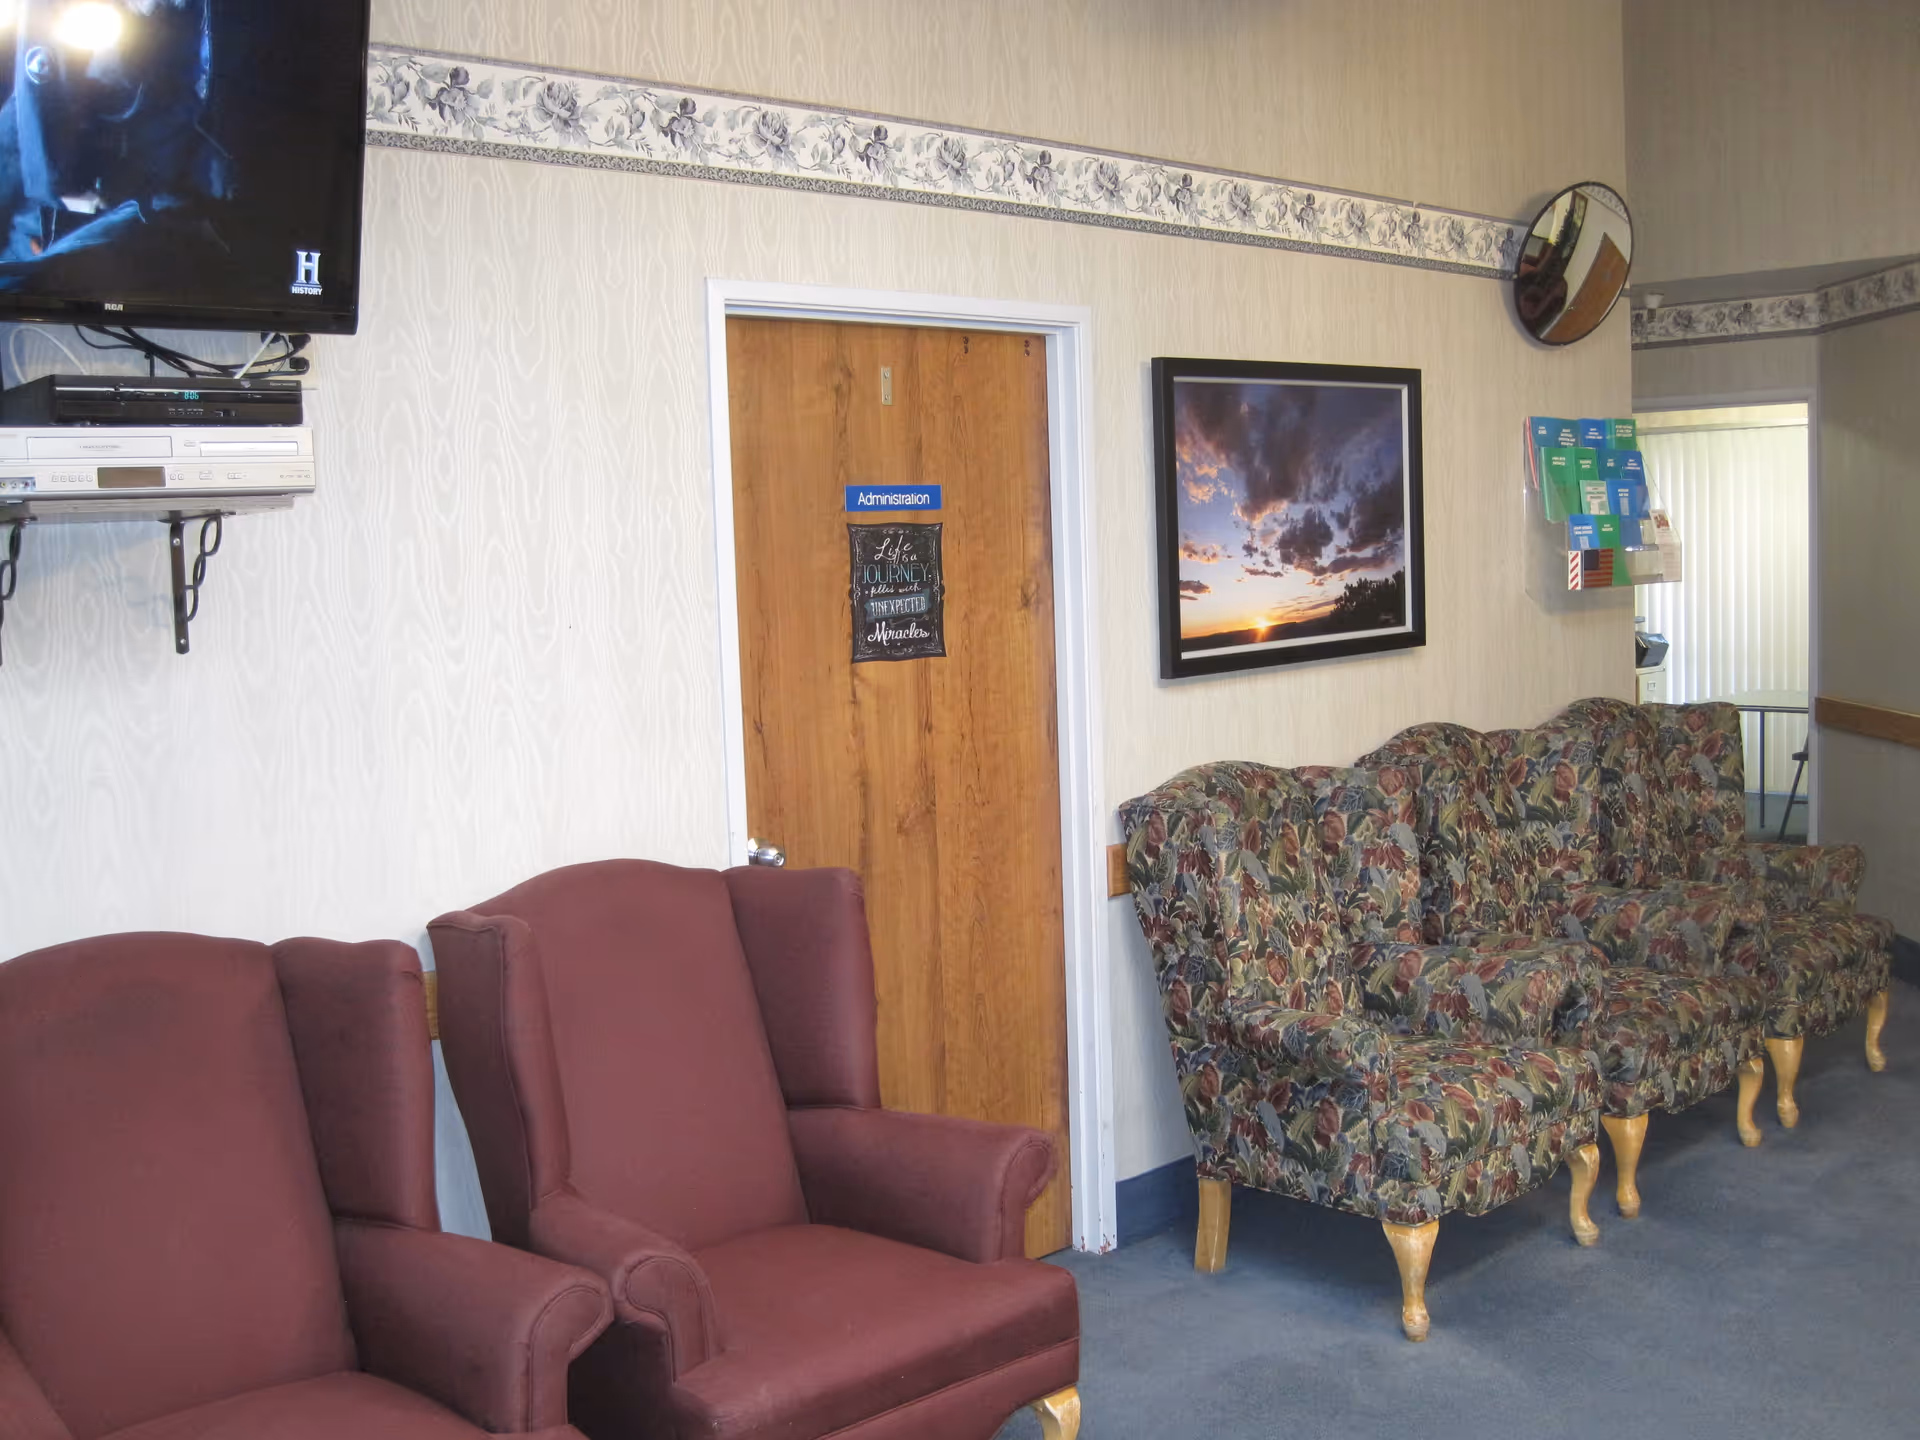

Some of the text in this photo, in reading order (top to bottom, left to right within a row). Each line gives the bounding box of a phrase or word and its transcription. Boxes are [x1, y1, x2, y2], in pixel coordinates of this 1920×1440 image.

[295, 250, 322, 285] H
[291, 286, 323, 295] HISTORY
[104, 303, 124, 311] RCA
[858, 491, 930, 506] Administration
[874, 535, 912, 565] Life
[862, 563, 929, 584] JOURNEY
[871, 596, 926, 617] UNEXPECTED
[868, 621, 930, 646] Miracles
